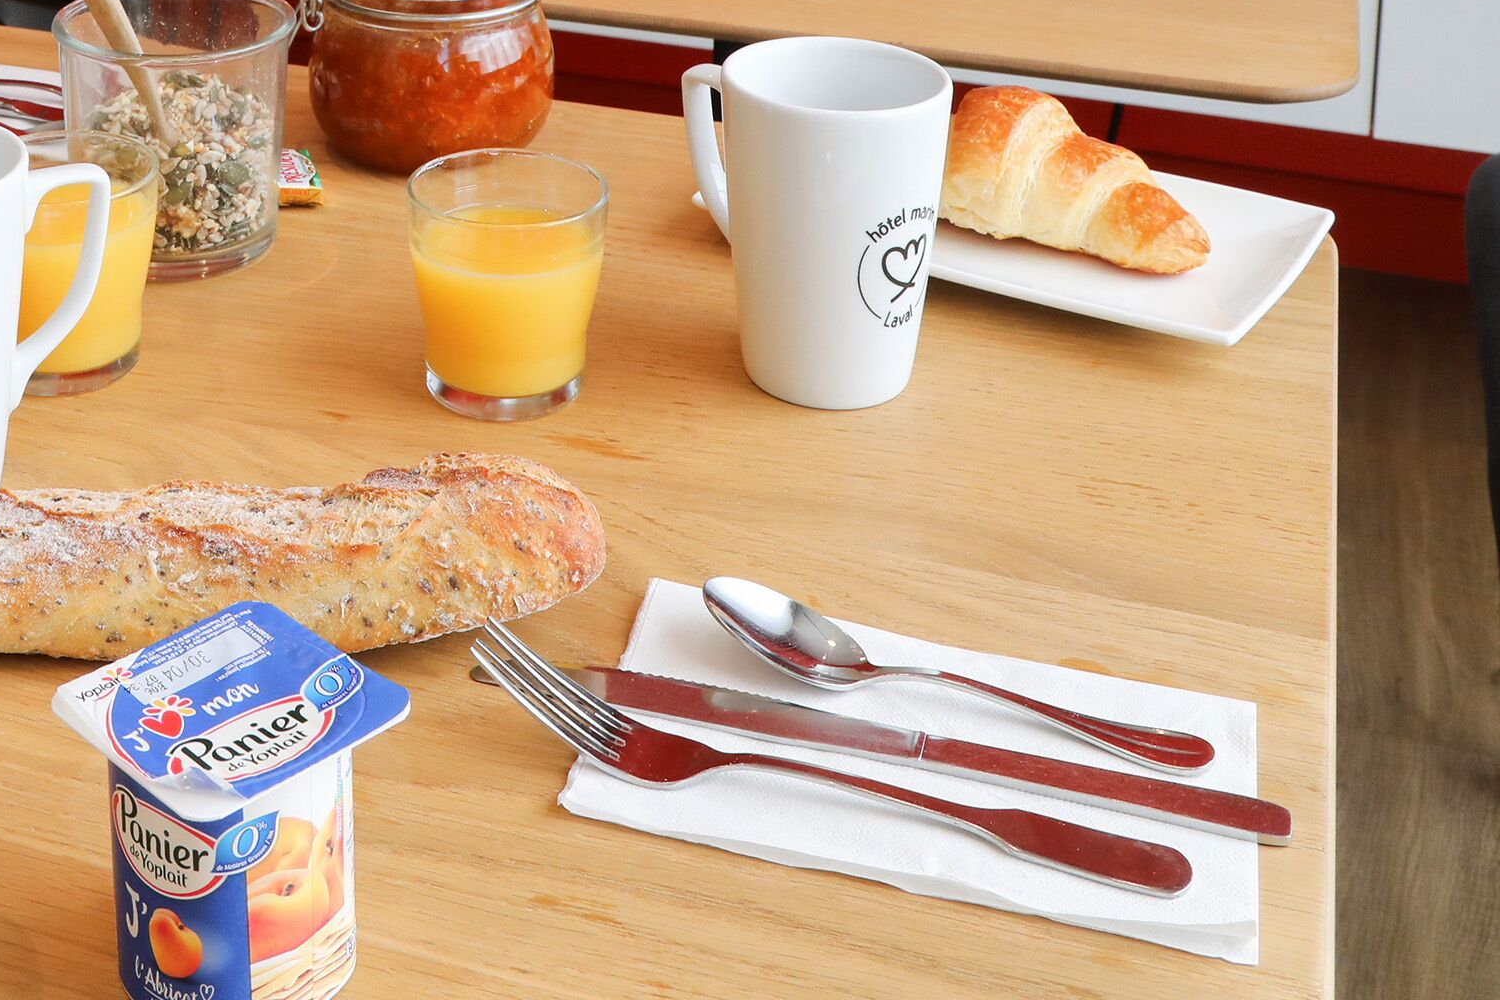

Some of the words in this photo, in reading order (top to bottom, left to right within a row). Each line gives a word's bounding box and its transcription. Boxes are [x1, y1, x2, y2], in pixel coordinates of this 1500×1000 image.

[911, 205, 935, 222] mari
[884, 305, 913, 328] Laval
[162, 650, 212, 683] 30/04
[201, 682, 260, 716] mon
[170, 703, 309, 771] Panier
[228, 760, 245, 772] de
[244, 729, 309, 766] Yoplait
[116, 786, 209, 872] Panier
[129, 844, 141, 860] de
[140, 851, 189, 888] Yoplait
